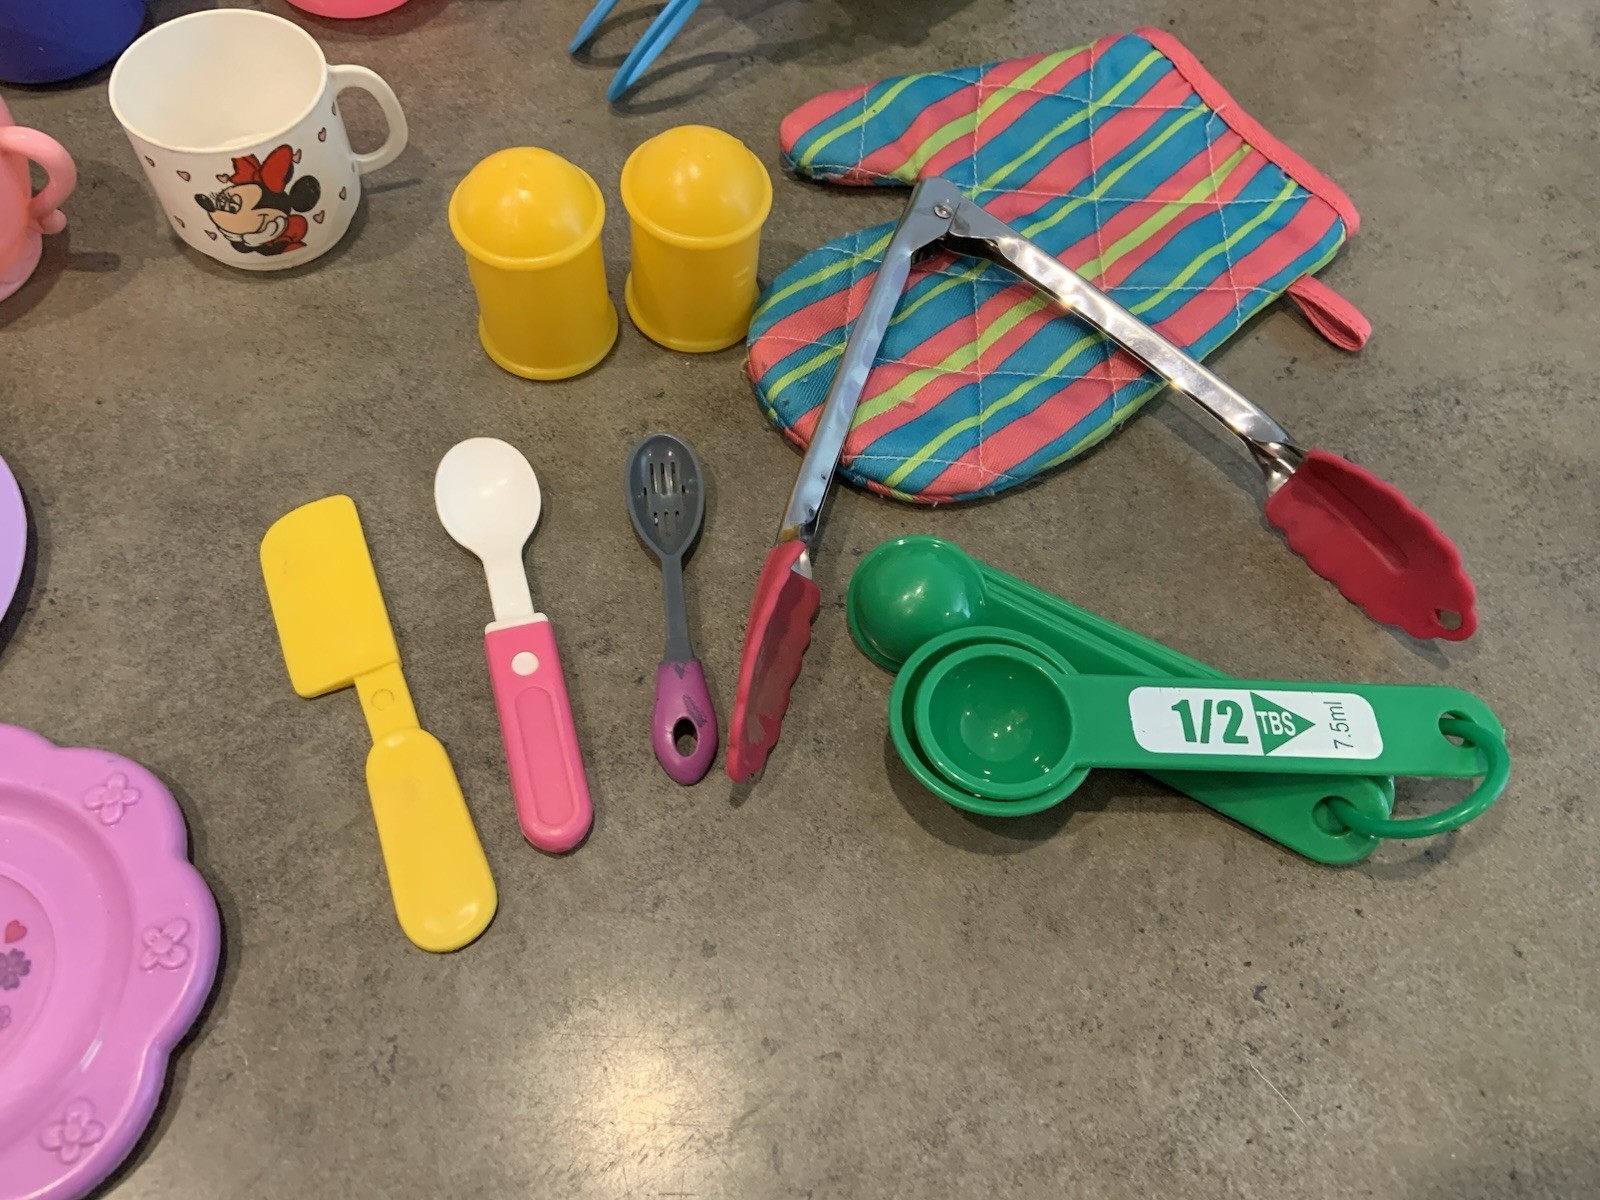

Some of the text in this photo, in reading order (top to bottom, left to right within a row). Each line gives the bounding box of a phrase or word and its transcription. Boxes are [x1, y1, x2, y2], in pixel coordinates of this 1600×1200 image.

[1171, 699, 1296, 744] 1/2 TBS
[1323, 701, 1354, 750] 7.5ml
